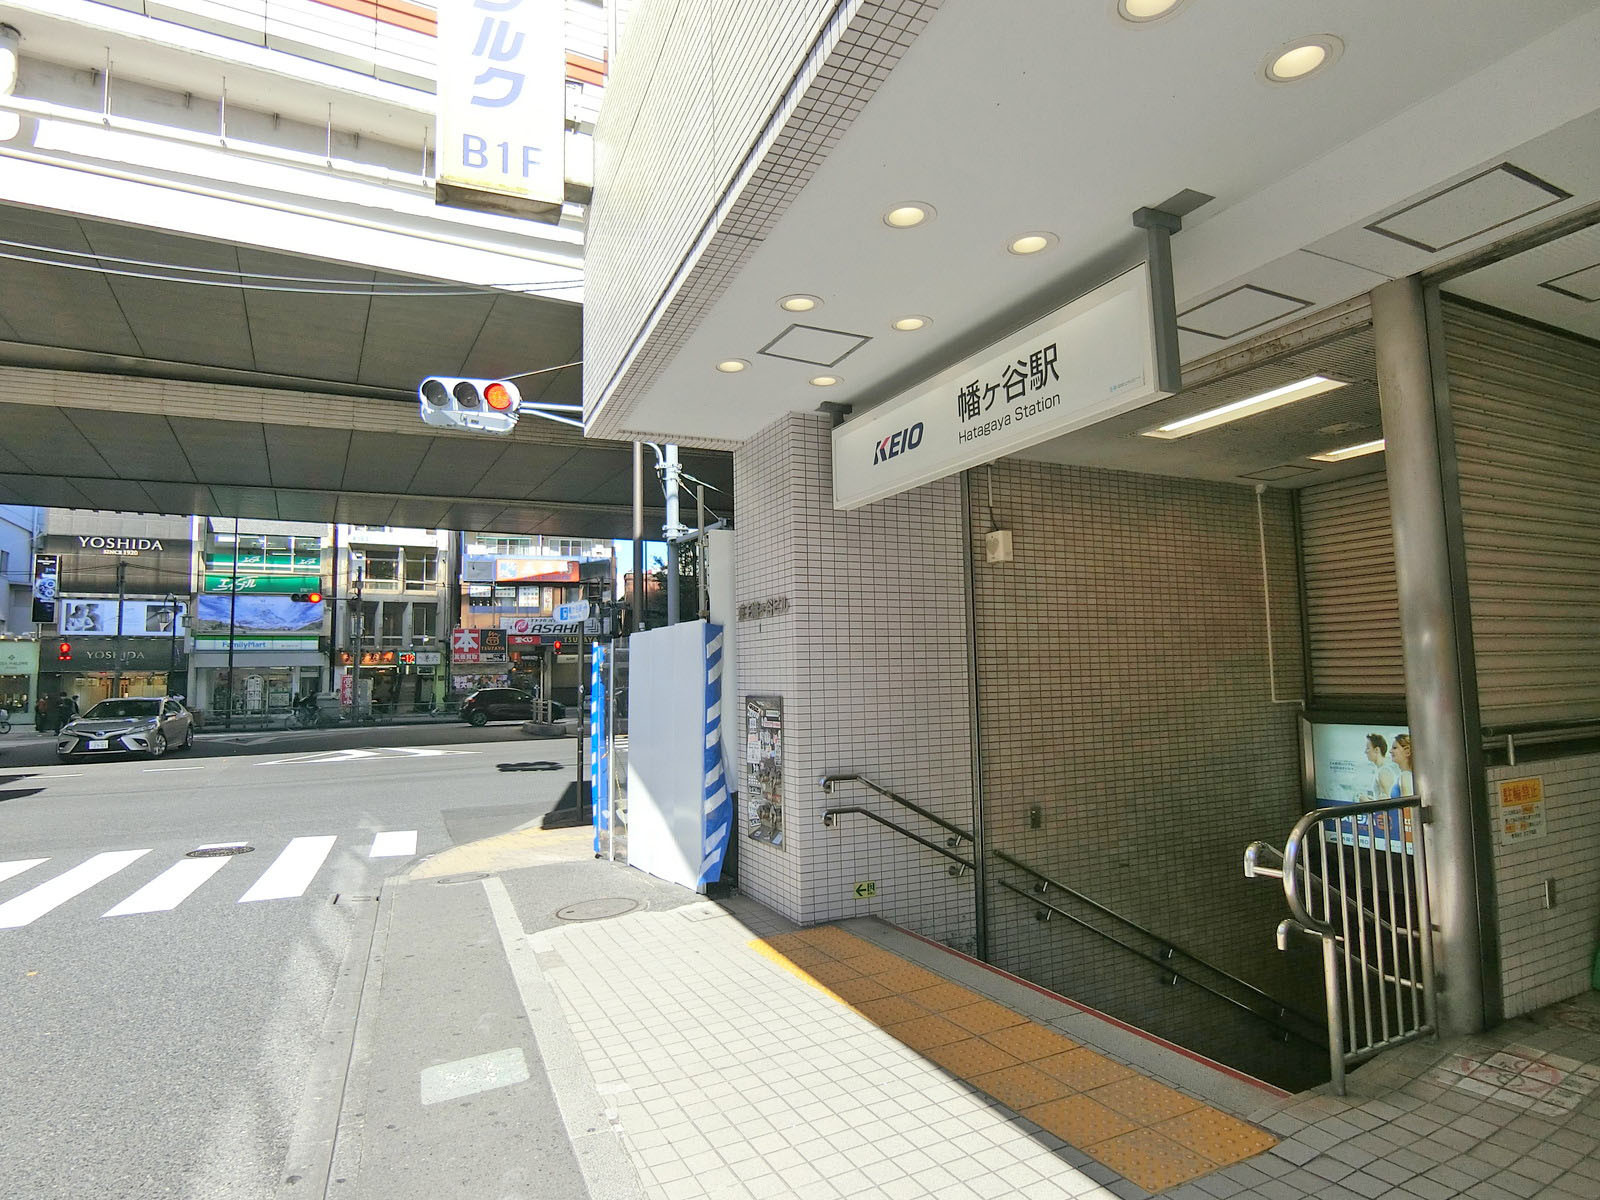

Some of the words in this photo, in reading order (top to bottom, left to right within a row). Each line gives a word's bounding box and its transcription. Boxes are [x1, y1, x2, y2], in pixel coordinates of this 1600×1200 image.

[471, 0, 526, 108] ルク
[463, 133, 542, 178] B1F
[957, 343, 1060, 424] 幡ヶ谷駅
[958, 415, 1012, 445] Hatagaya
[1014, 394, 1061, 421] Station
[873, 421, 924, 466] KEIO
[79, 536, 164, 551] YOSHIDA
[222, 641, 266, 650] FmilyMart
[455, 629, 479, 652] 本
[531, 624, 579, 633] ASAHI
